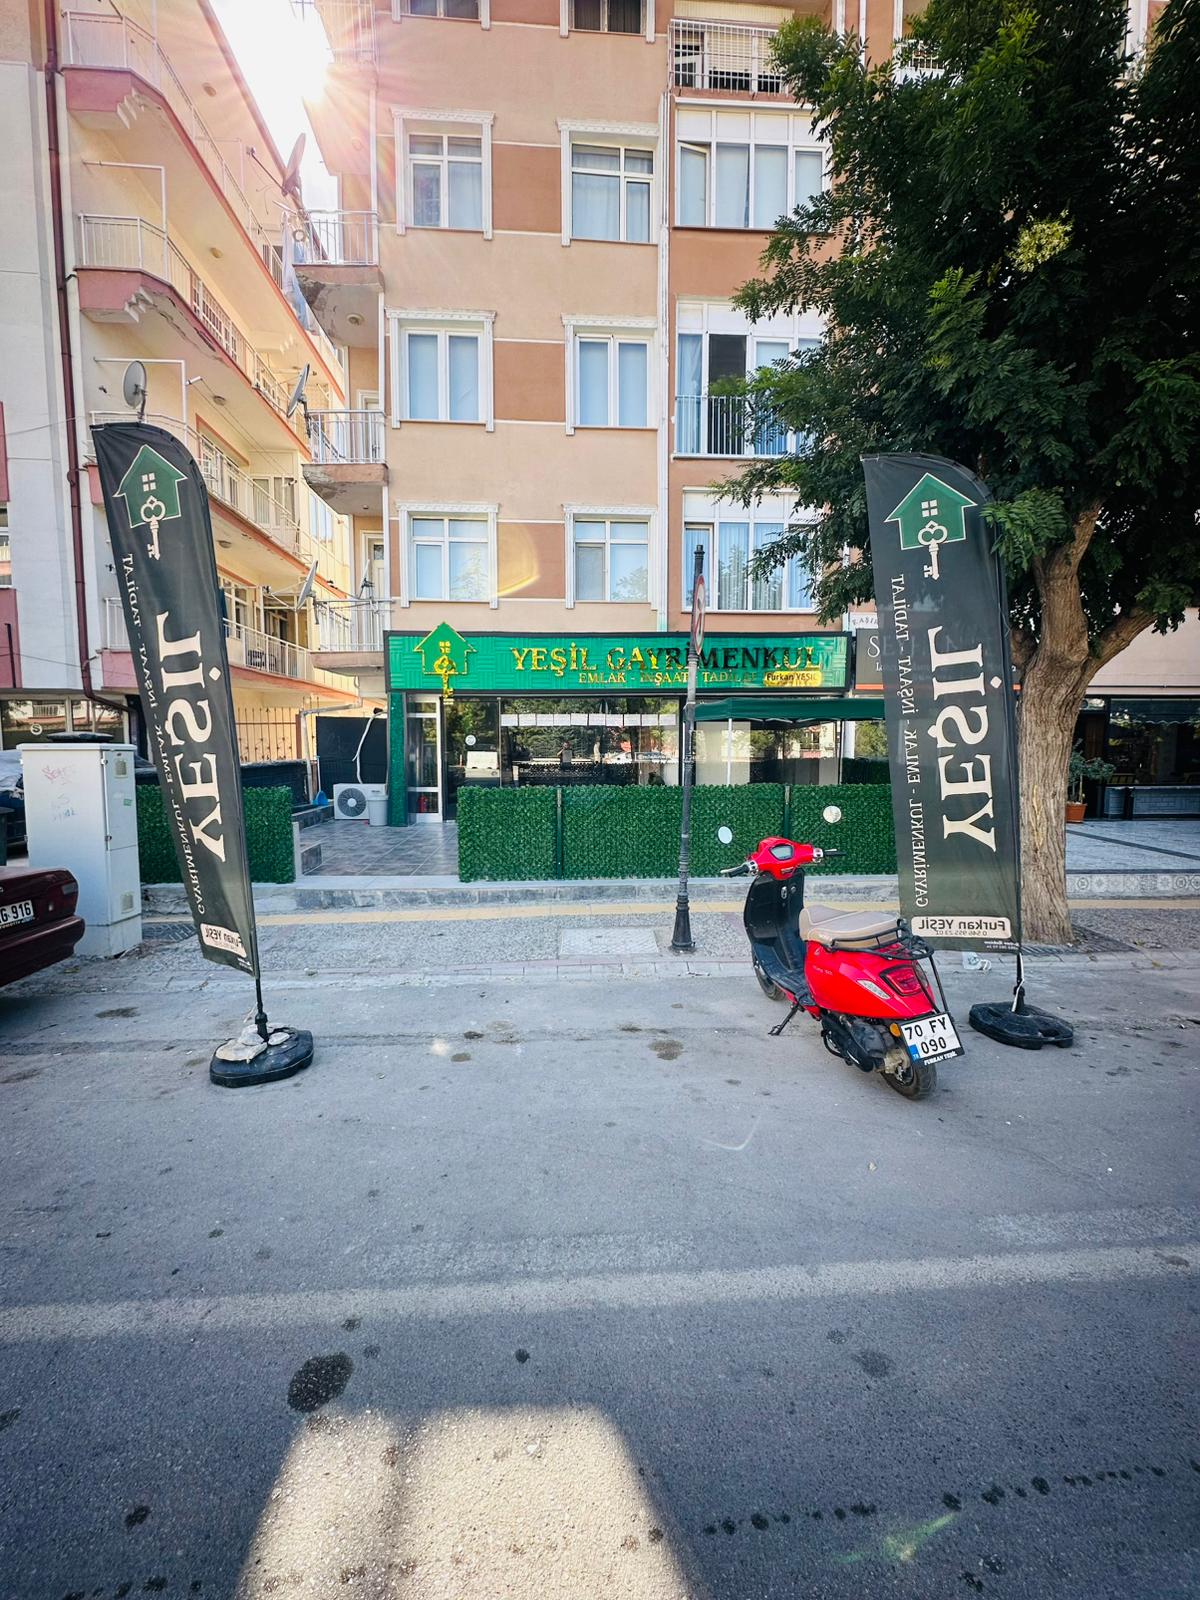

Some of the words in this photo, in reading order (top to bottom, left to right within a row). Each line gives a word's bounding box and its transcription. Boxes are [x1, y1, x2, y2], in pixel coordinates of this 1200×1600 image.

[510, 641, 597, 677] YEŞİL
[606, 641, 821, 670] GAYRİMENKUL
[578, 671, 626, 684] EMLAK
[640, 669, 689, 686] İNŞAAT
[766, 672, 794, 681] Furkan
[11, 902, 31, 919] 916
[904, 1025, 923, 1040] 70
[929, 1017, 946, 1034] FY
[921, 1036, 947, 1054] 090
